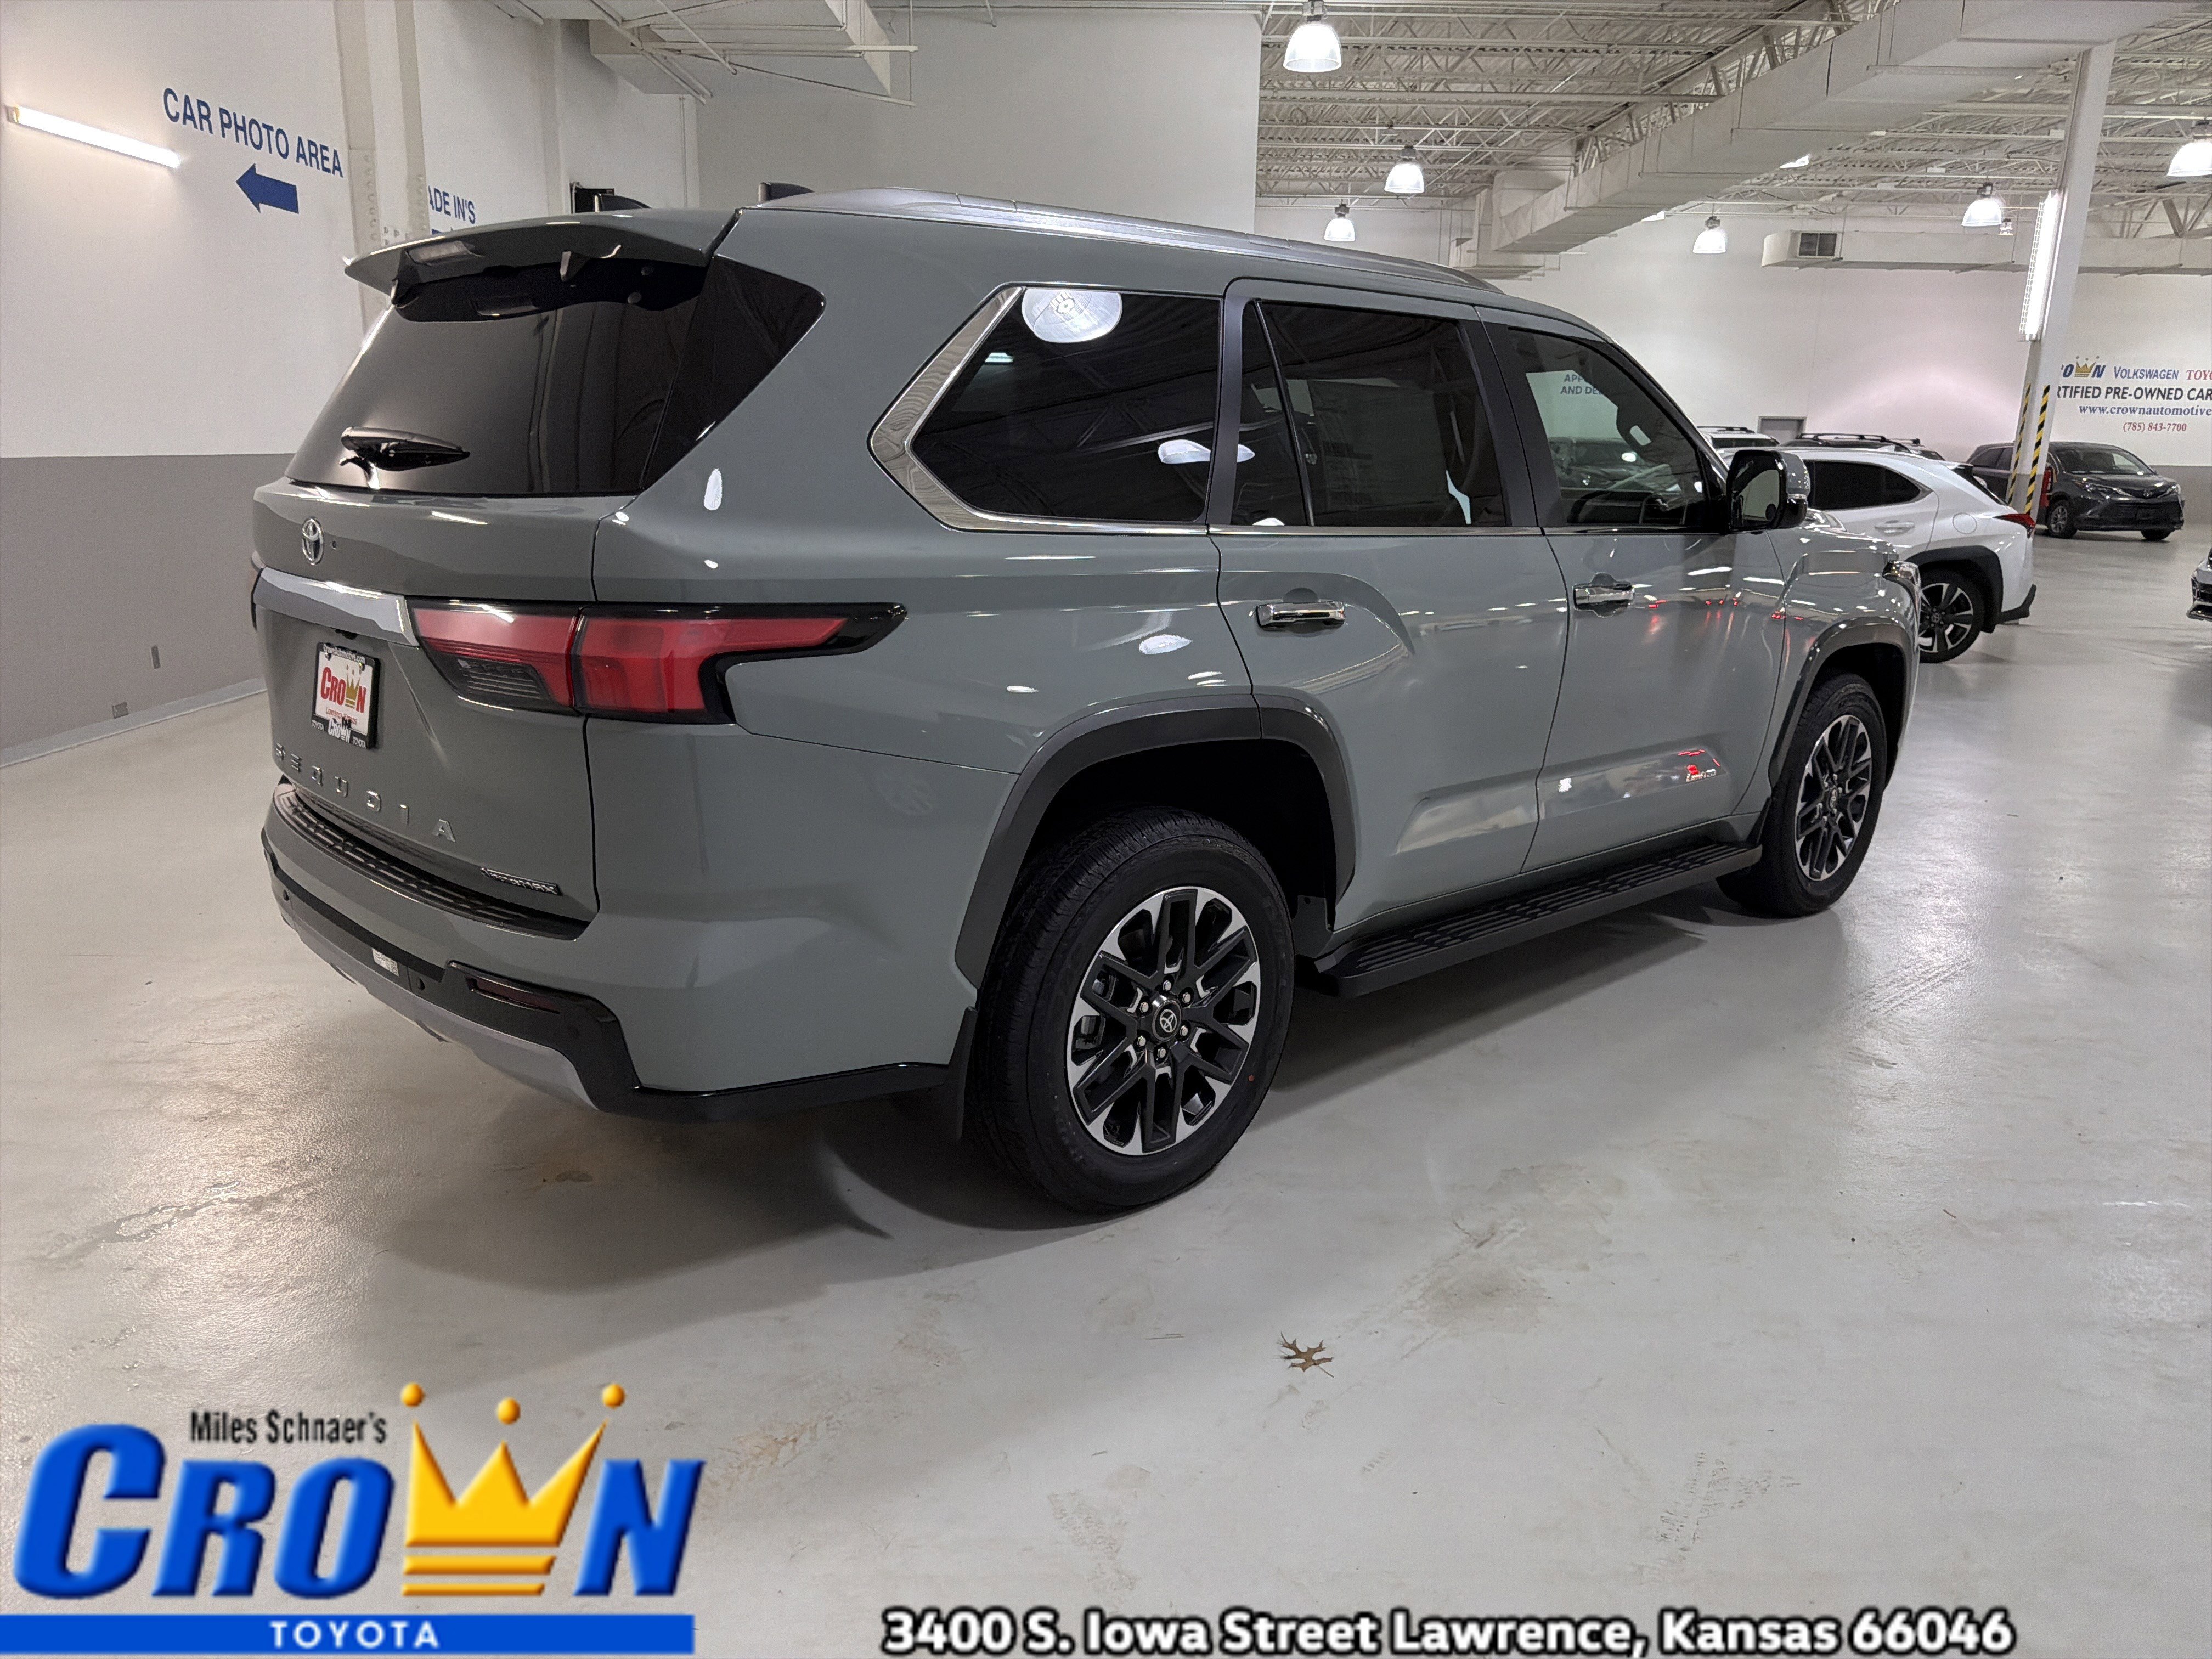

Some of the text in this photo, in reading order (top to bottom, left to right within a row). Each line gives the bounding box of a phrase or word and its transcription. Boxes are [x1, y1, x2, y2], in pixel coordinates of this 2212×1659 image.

[163, 88, 343, 178] CAR PHOTO AREA
[453, 195, 476, 224] IN'S
[2061, 356, 2107, 378] OWN
[2113, 365, 2179, 380] VOLKSWAGEN
[1560, 386, 1583, 394] AND
[2104, 386, 2184, 400] PRE-OWNED
[2078, 404, 2212, 416] www.crownautomotive
[2123, 421, 2187, 432] (785) 843-7700
[352, 736, 366, 749] TOYOTA
[275, 743, 456, 843] SEQUOIA
